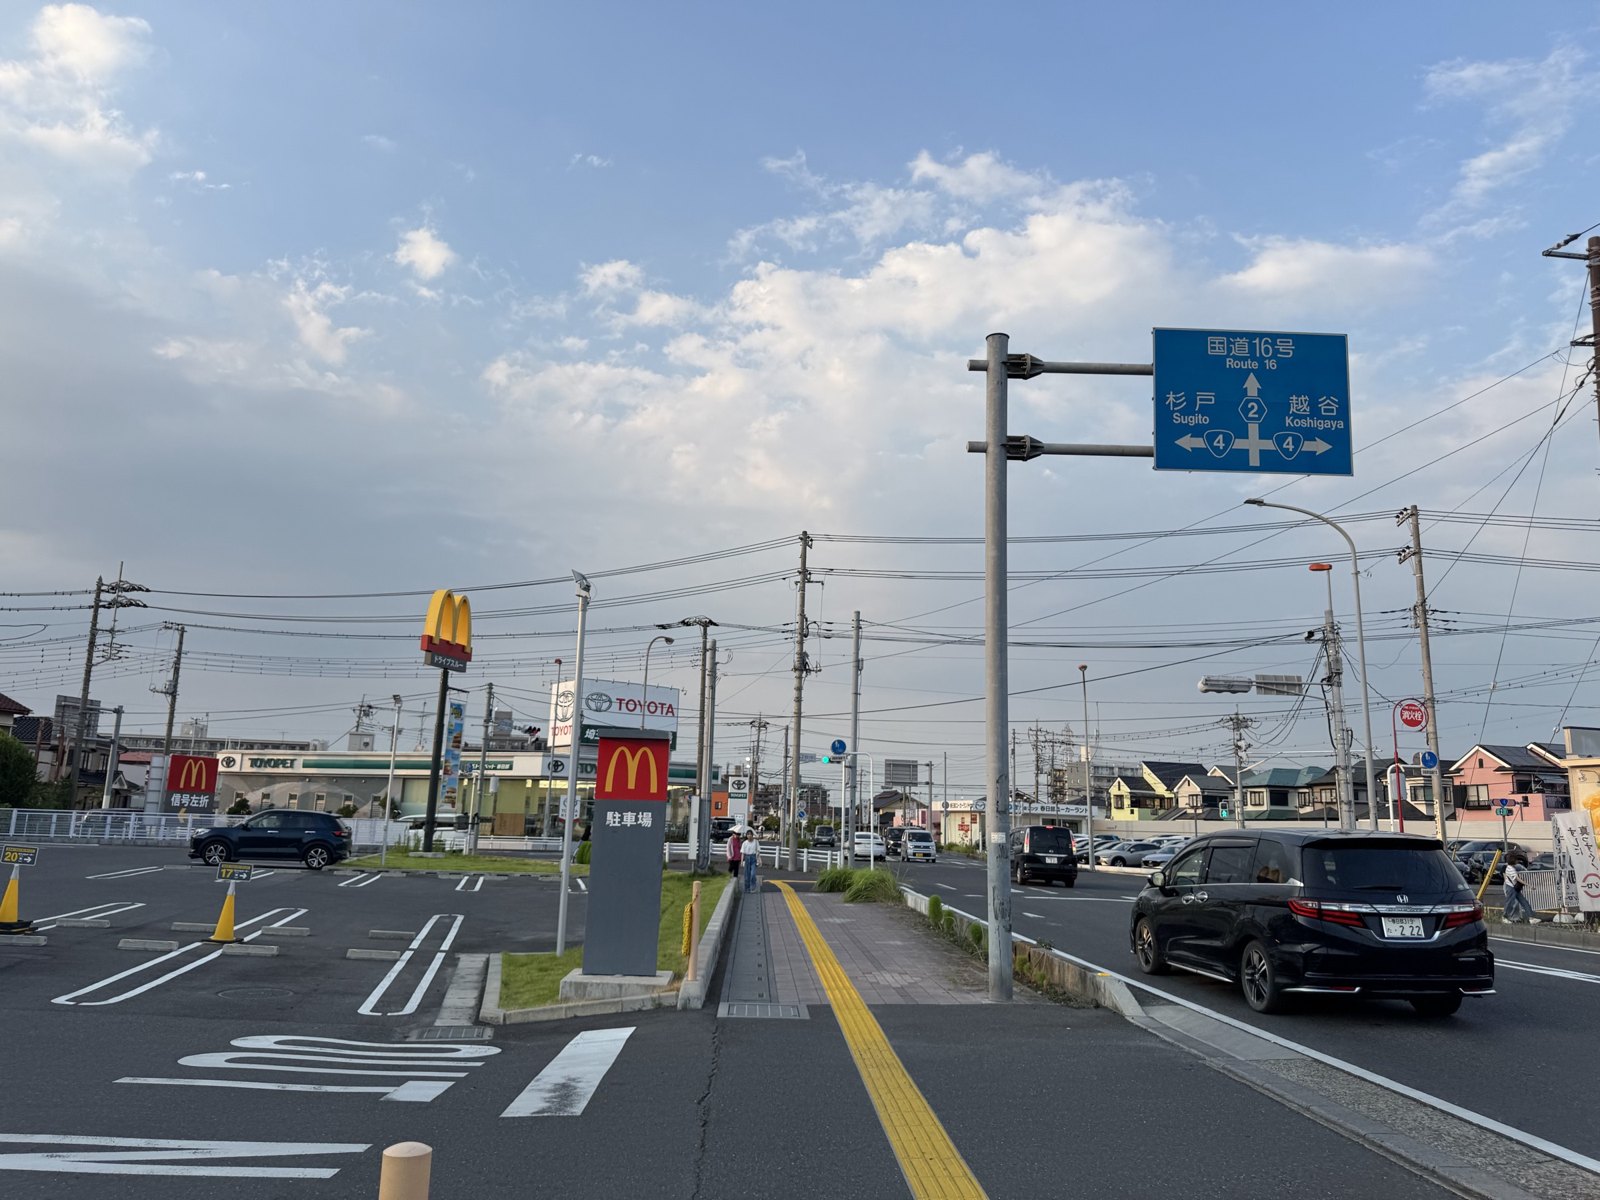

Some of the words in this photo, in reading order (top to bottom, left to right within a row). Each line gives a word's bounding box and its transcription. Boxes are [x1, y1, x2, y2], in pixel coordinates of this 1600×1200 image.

[1207, 336, 1295, 358] 国道16号
[1226, 358, 1259, 369] Route
[1264, 359, 1277, 370] 16
[1165, 391, 1216, 411] 杉戸
[1289, 394, 1339, 416] 越谷
[1247, 402, 1259, 418] 2
[1172, 412, 1210, 426] Sugito
[1285, 416, 1344, 431] Koshigaya
[1213, 434, 1225, 450] 4
[1283, 436, 1295, 452] 4
[616, 698, 675, 717] TOYOTA
[551, 725, 573, 737] TOYOT
[248, 757, 297, 769] TOYOPET
[171, 793, 209, 808] 信号左折
[605, 811, 653, 828] 駐車場
[221, 868, 234, 878] 17
